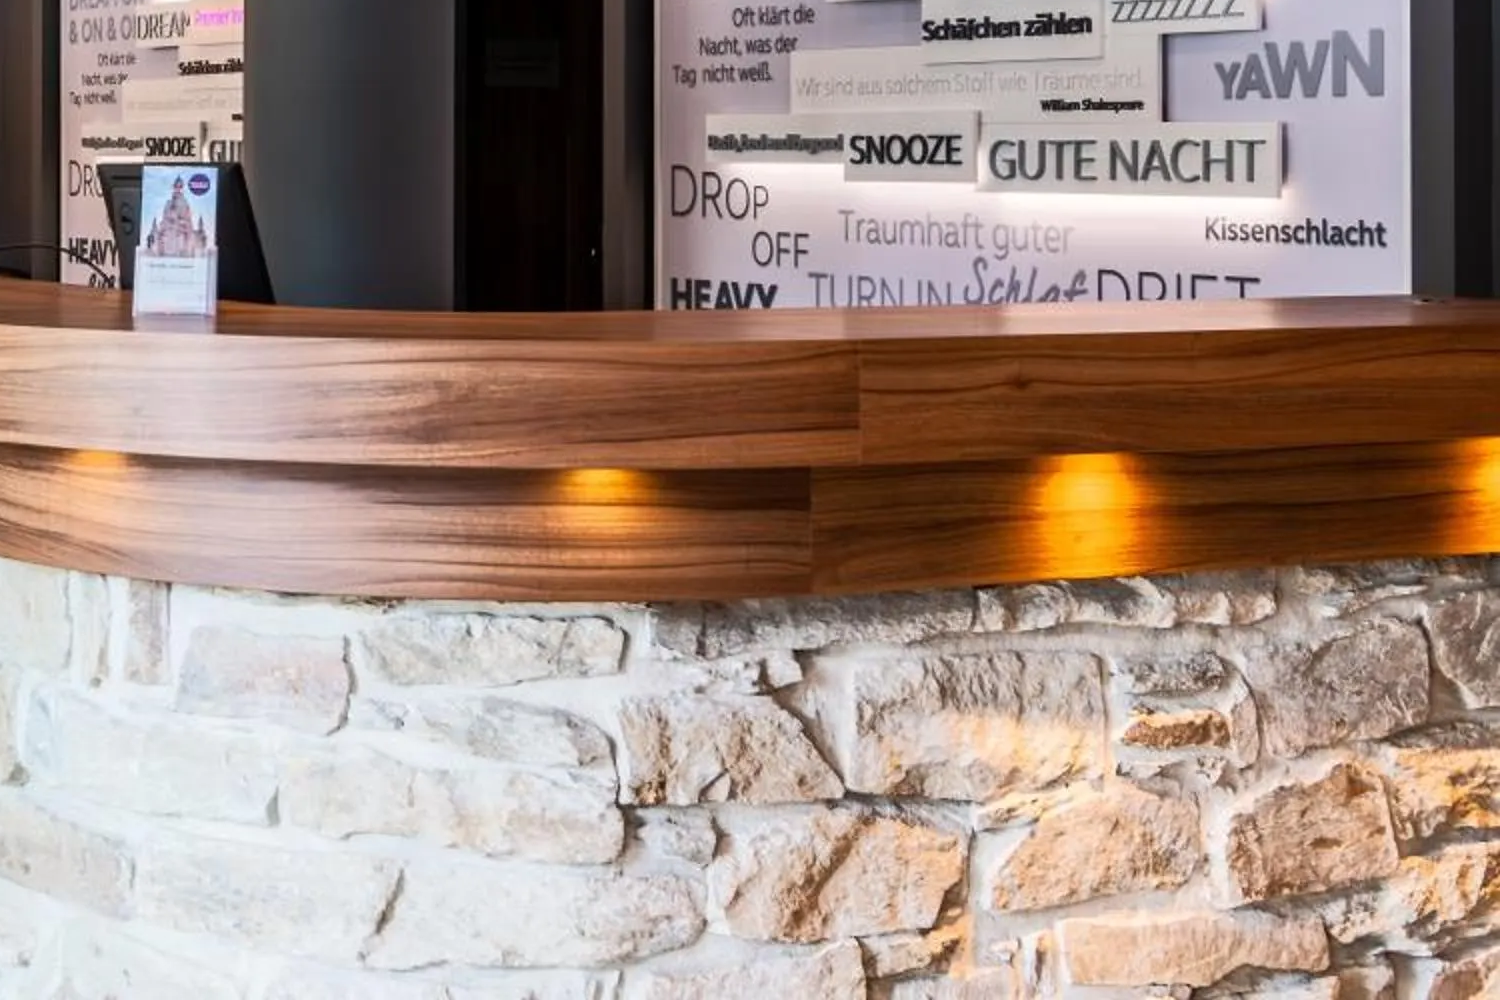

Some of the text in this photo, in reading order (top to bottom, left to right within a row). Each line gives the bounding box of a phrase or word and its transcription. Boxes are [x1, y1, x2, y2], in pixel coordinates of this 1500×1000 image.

[732, 3, 816, 28] Oft klärt die
[922, 12, 1093, 42] Schäfchen zählen
[699, 34, 798, 56] Nacht, was der
[672, 65, 697, 88] Tag
[702, 63, 735, 83] nicht
[1214, 28, 1385, 101] YAWN
[145, 136, 196, 157] SNOOZE
[849, 134, 963, 166] SNOOZE
[989, 139, 1267, 184] GUTE NACHT
[671, 164, 770, 219] DROP
[838, 209, 1076, 260] Traumhaft guter
[1204, 214, 1388, 248] Kissenschlacht
[751, 230, 810, 268] OFF
[670, 277, 779, 310] HEAVY
[808, 272, 951, 308] TURN IN
